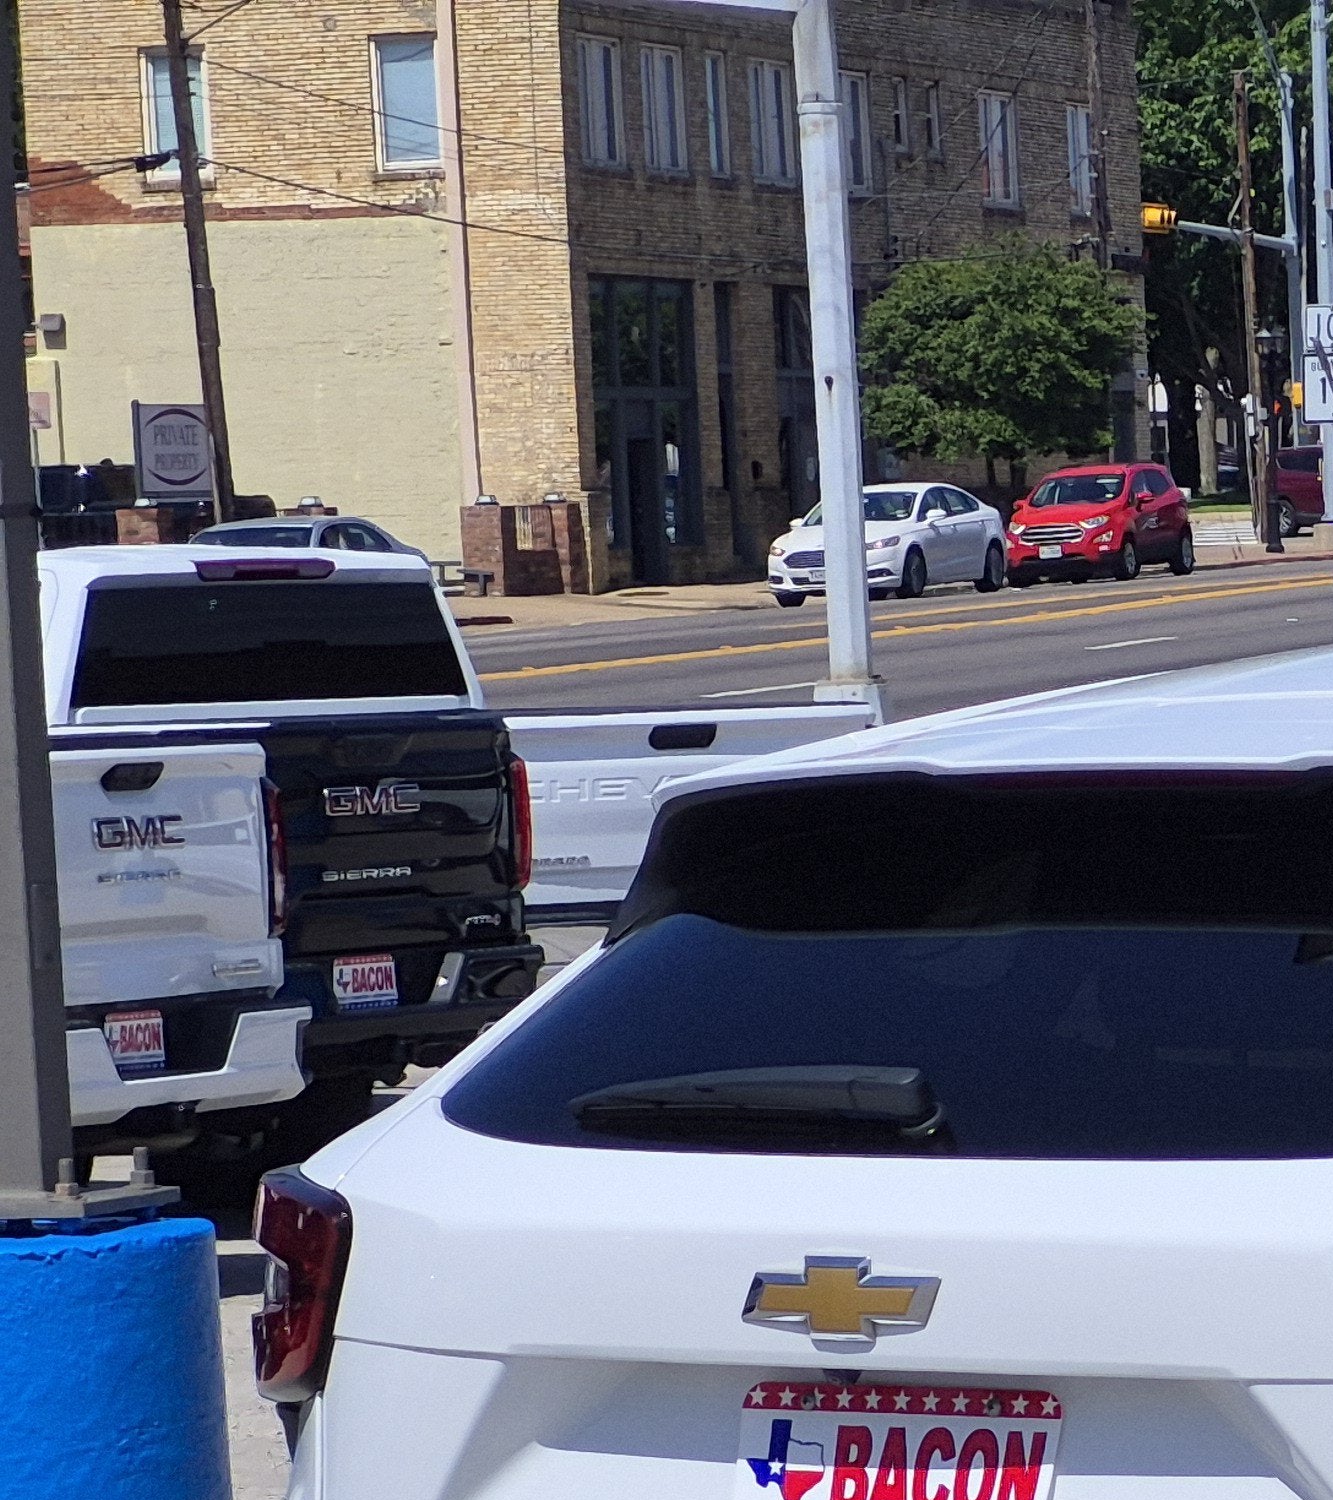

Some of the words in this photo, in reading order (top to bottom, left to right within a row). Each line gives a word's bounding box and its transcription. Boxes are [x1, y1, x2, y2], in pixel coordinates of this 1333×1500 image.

[153, 424, 199, 446] PRIVATE
[323, 783, 420, 816] GMC
[91, 815, 186, 850] GMC
[322, 866, 412, 881] SIERRA
[352, 967, 394, 993] BACON
[120, 1023, 162, 1053] BACON
